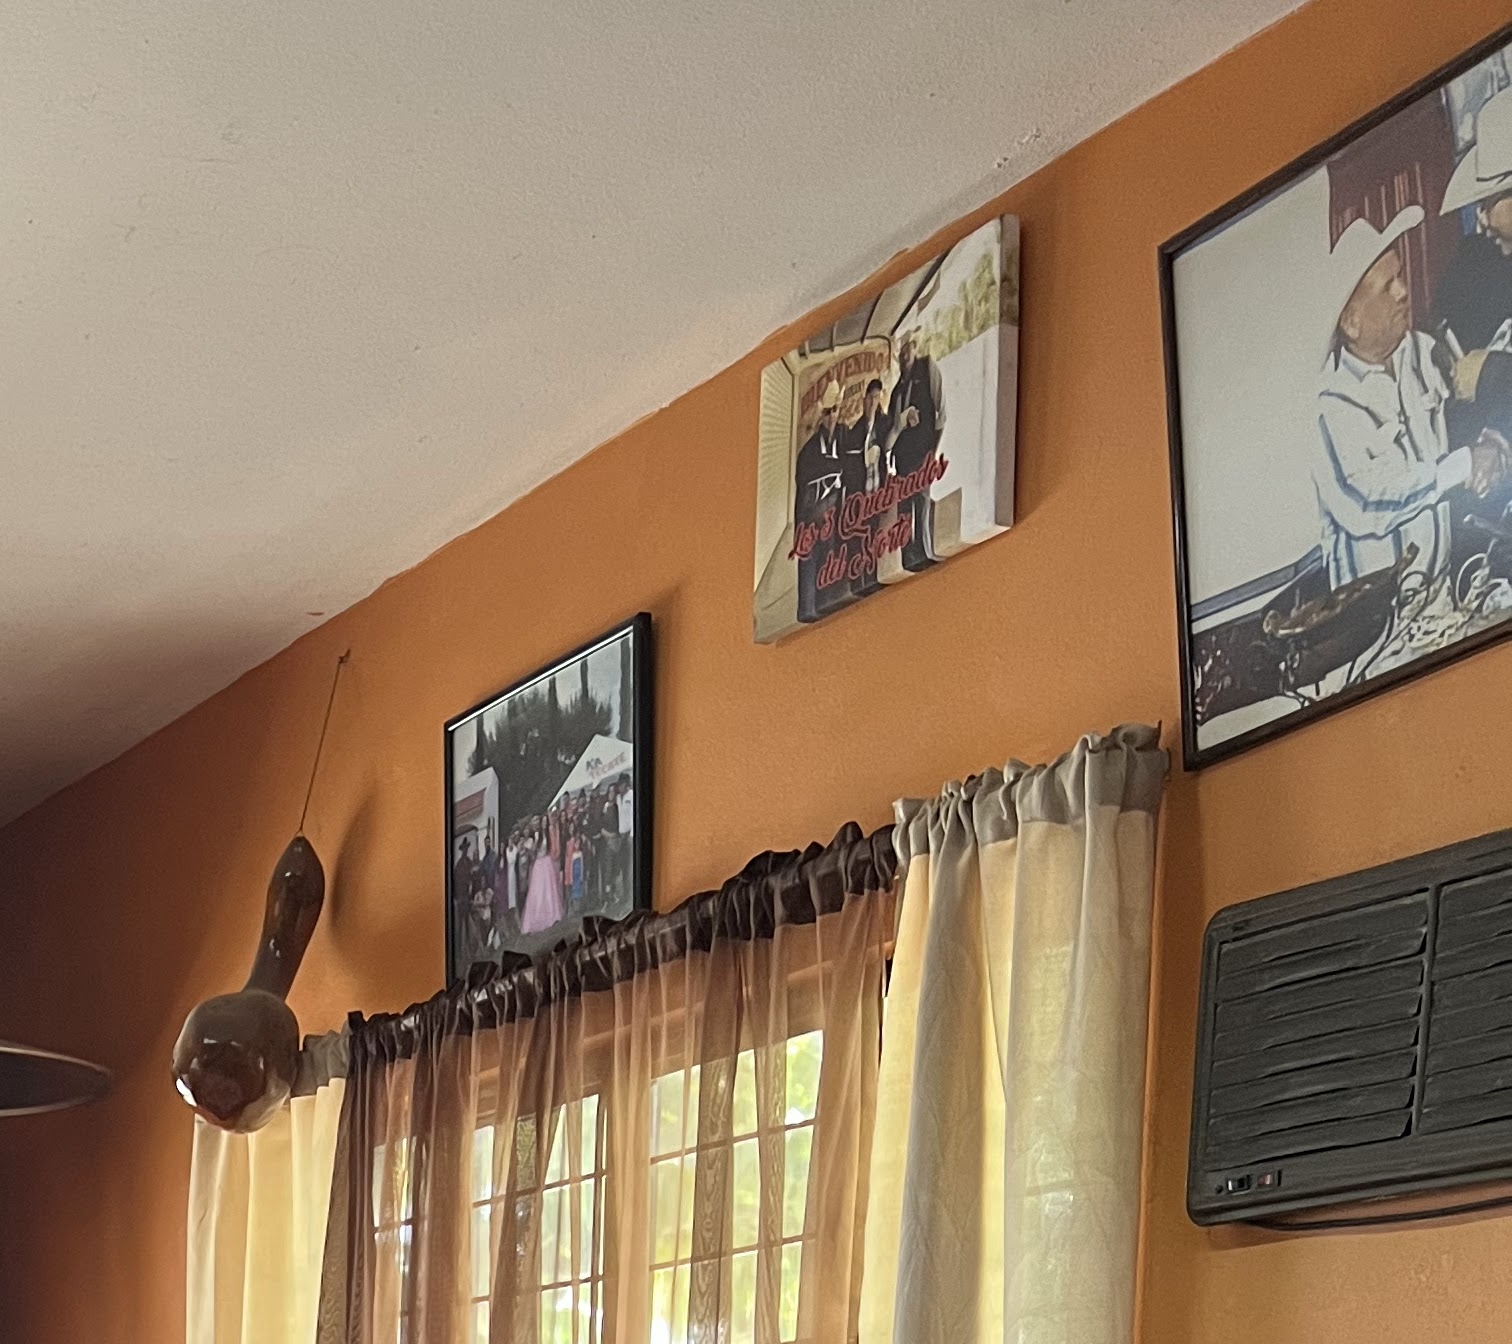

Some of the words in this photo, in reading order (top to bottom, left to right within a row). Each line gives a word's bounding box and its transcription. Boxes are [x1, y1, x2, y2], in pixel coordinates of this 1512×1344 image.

[788, 522, 816, 560] Los
[820, 508, 835, 541] 3
[839, 451, 949, 540] Quebrados
[816, 543, 847, 590] del
[848, 514, 912, 580] Norte
